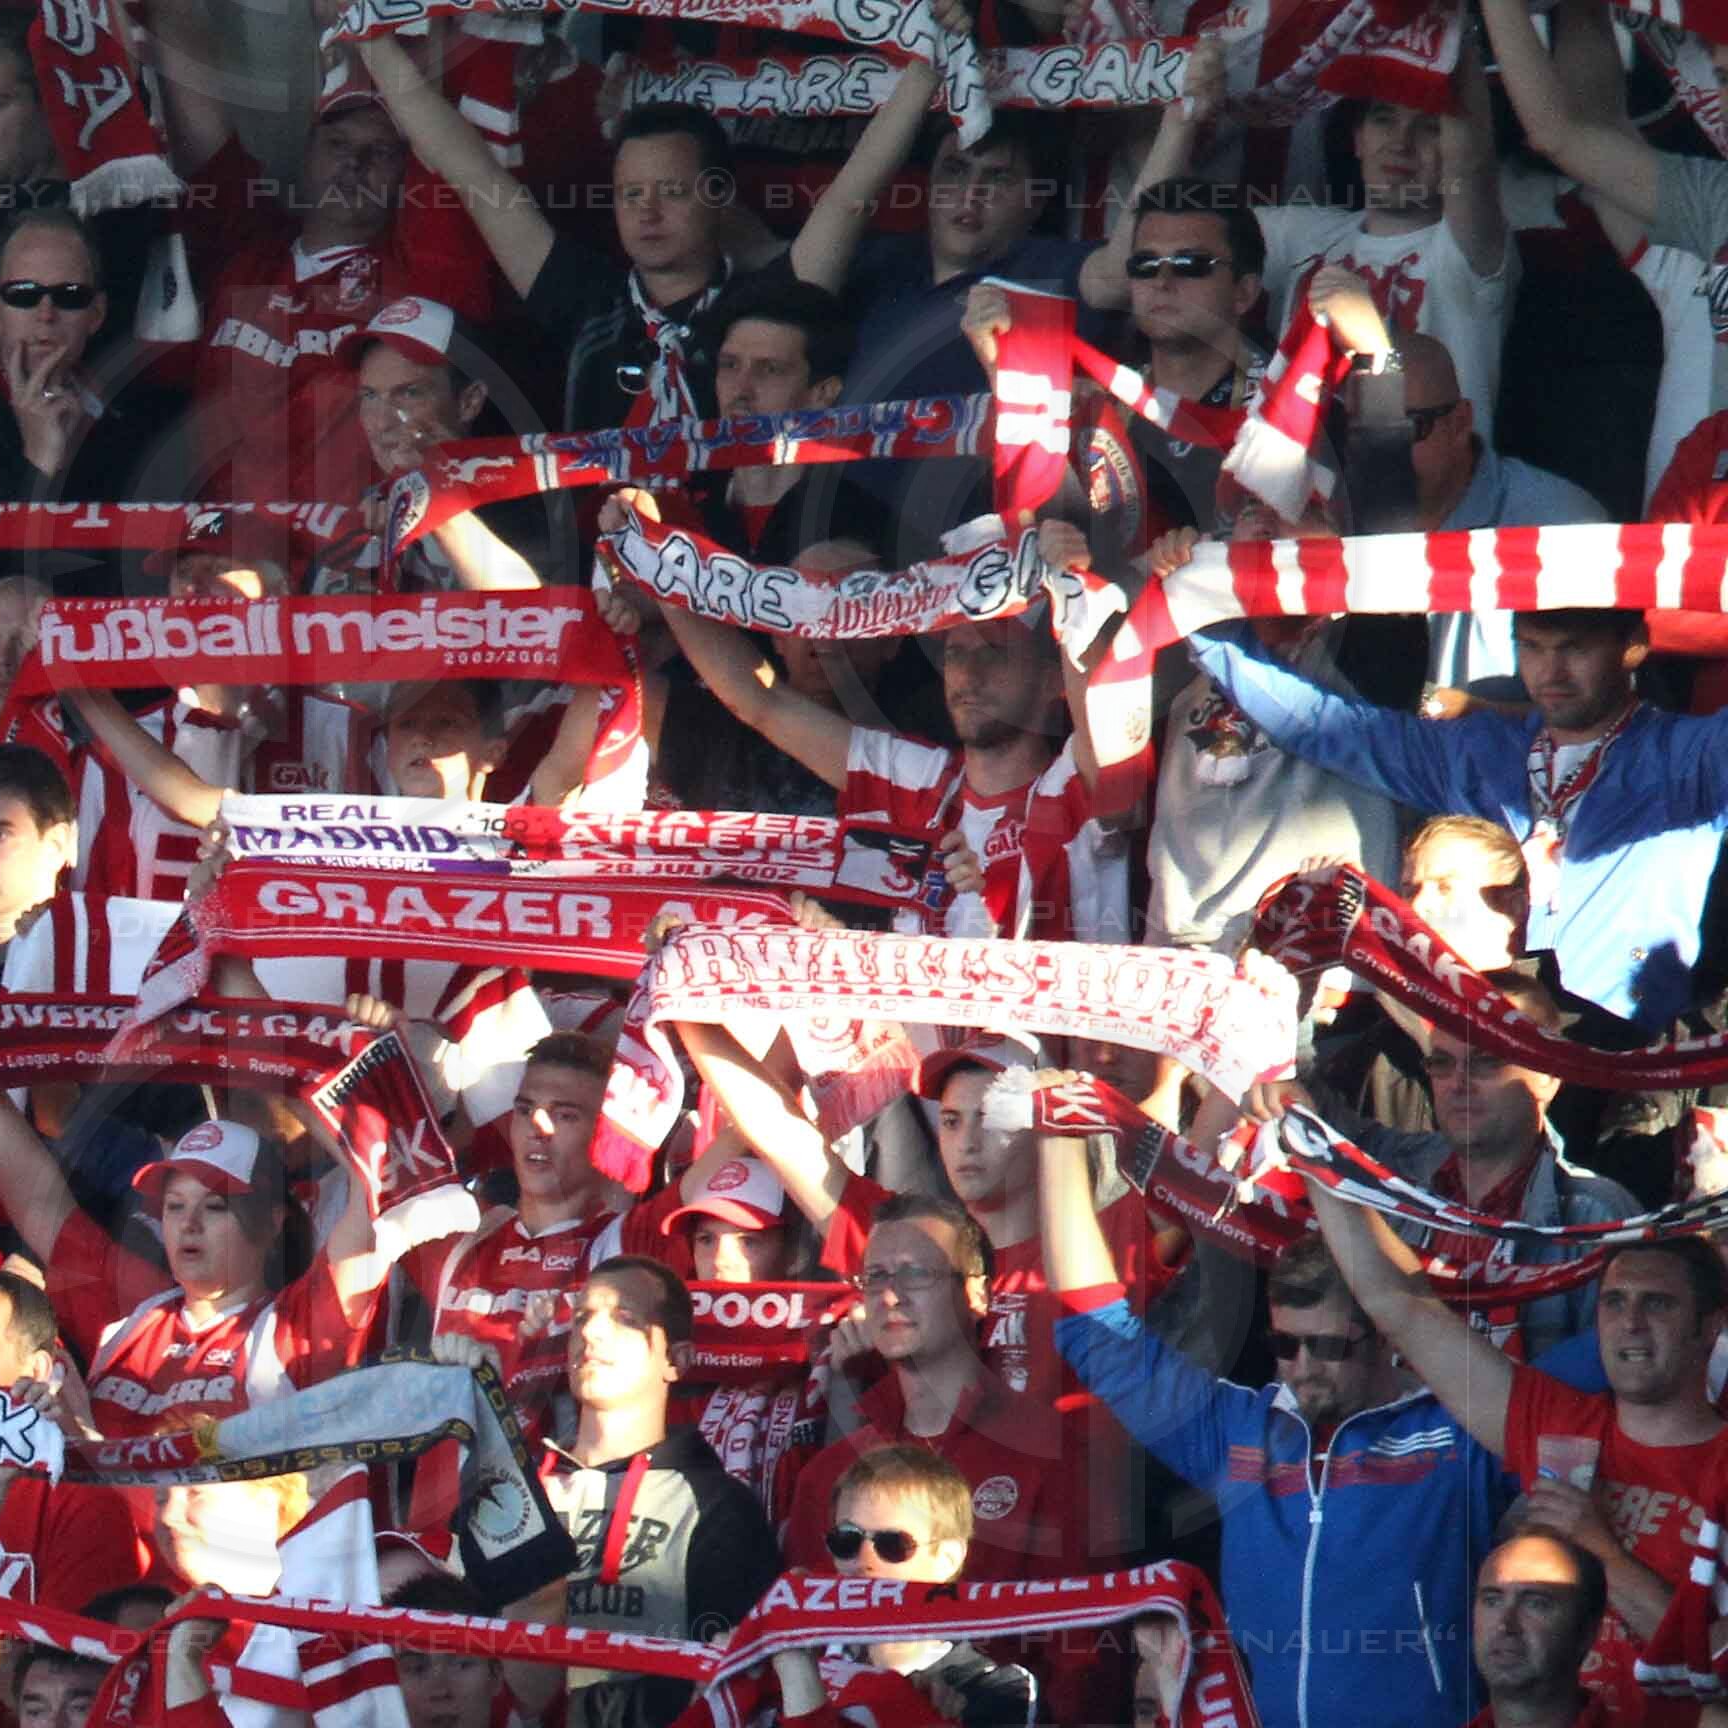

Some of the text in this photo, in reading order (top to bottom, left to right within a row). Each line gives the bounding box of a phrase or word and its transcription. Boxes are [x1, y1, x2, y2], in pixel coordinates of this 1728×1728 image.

[746, 58, 889, 113] ARE
[1028, 41, 1182, 104] GAK
[655, 531, 800, 628] ARE
[38, 598, 584, 666] fußball meister
[232, 825, 460, 852] MADRID
[281, 804, 391, 821] REAL
[558, 806, 840, 837] GRAZER
[649, 863, 714, 880] JULI
[717, 864, 798, 884] 2002
[256, 880, 613, 938] GRAZER
[1369, 906, 1467, 996] GAK
